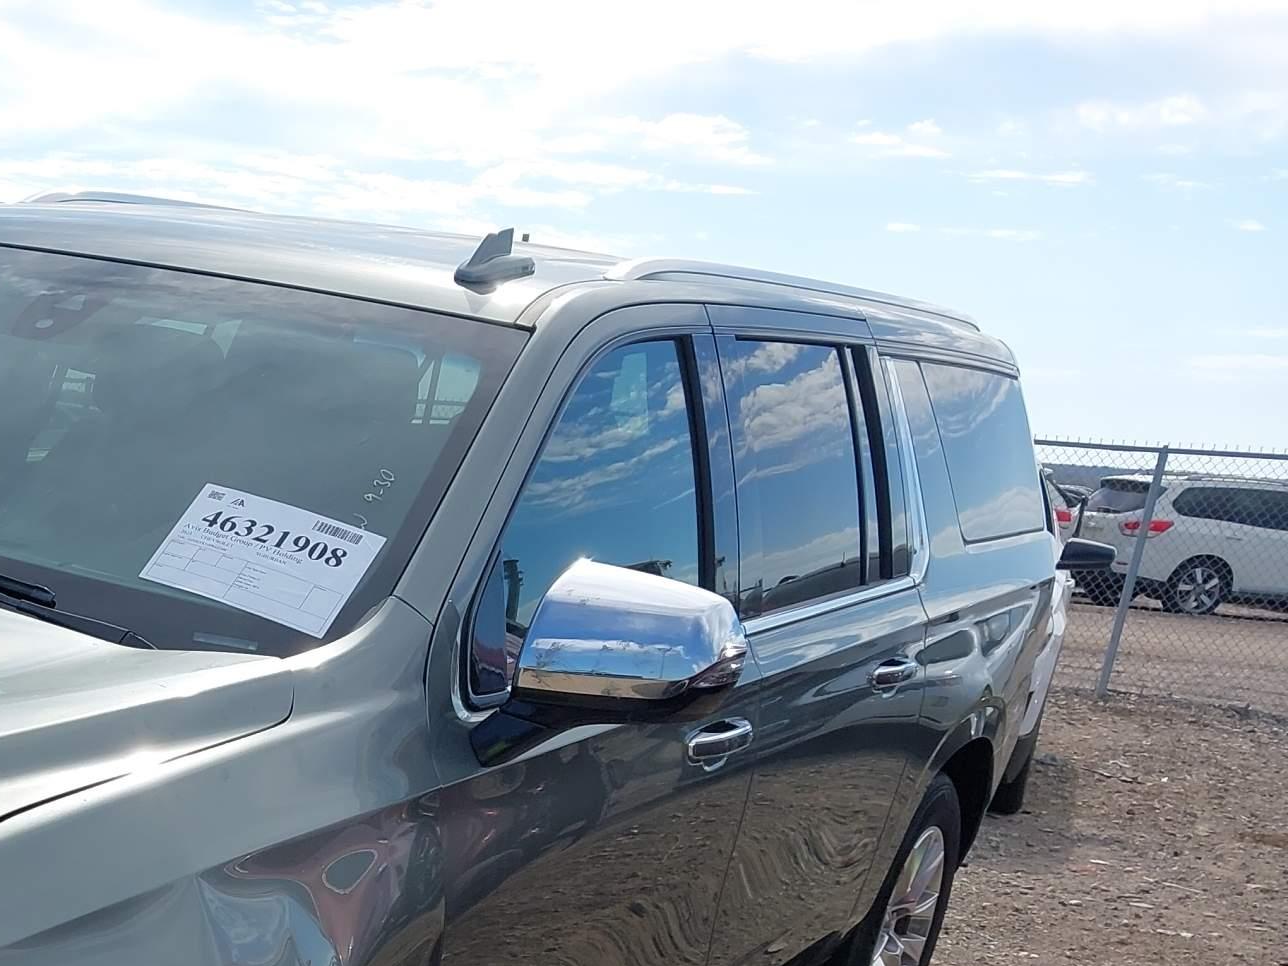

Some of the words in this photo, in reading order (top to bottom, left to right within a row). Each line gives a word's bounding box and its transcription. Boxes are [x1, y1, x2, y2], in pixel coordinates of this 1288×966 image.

[201, 510, 348, 568] 46321908
[202, 527, 230, 540] Budget
[229, 535, 254, 548] Group
[272, 547, 304, 565] Holding
